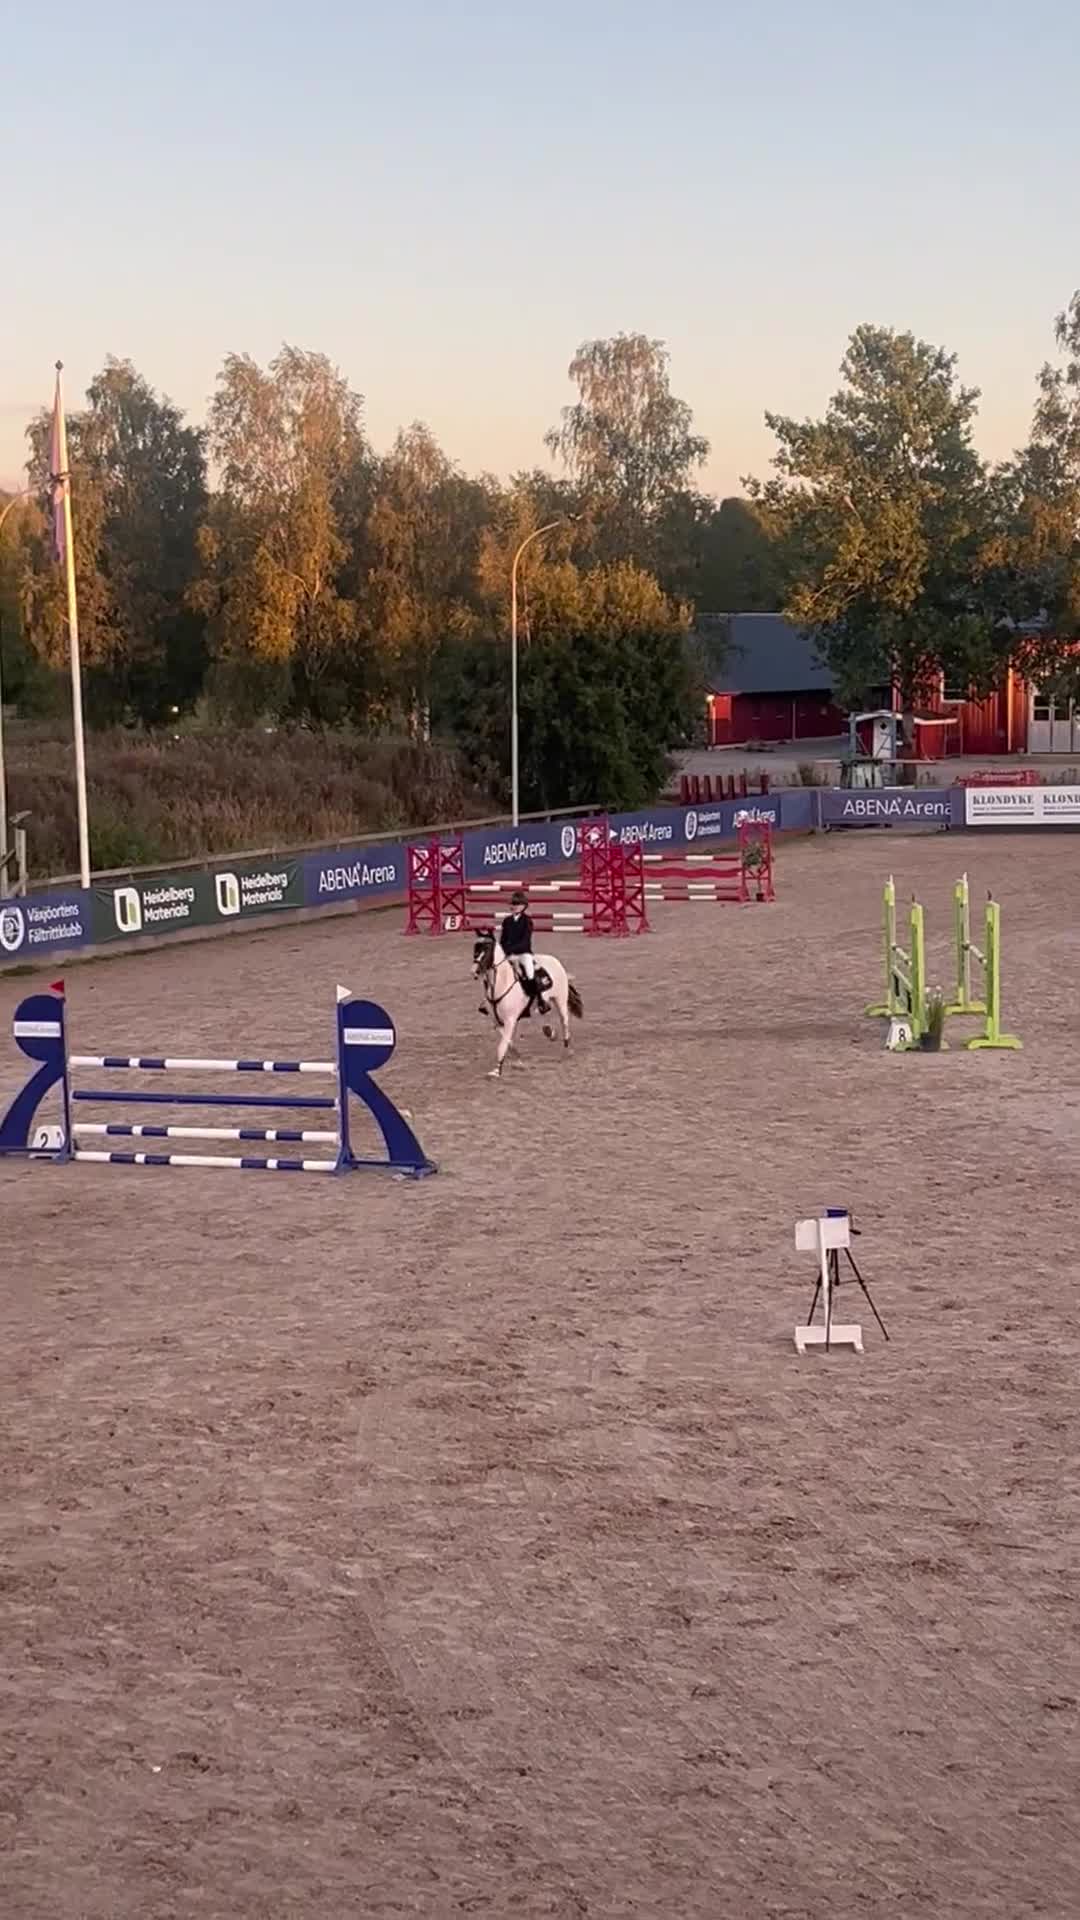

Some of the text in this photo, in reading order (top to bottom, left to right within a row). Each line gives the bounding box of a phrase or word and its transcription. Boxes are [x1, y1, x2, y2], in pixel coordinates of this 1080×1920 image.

[903, 799, 952, 815] Arena
[973, 794, 1034, 805] KLONDYKE
[648, 823, 672, 840] Arena
[519, 840, 547, 860] Arena
[241, 872, 287, 890] Heidelberg
[361, 864, 396, 886] Arena
[143, 887, 195, 905] Heidelberg
[242, 888, 283, 906] Materials
[144, 903, 189, 922] Materials
[899, 1028, 908, 1042] 8
[40, 1132, 49, 1149] 2
